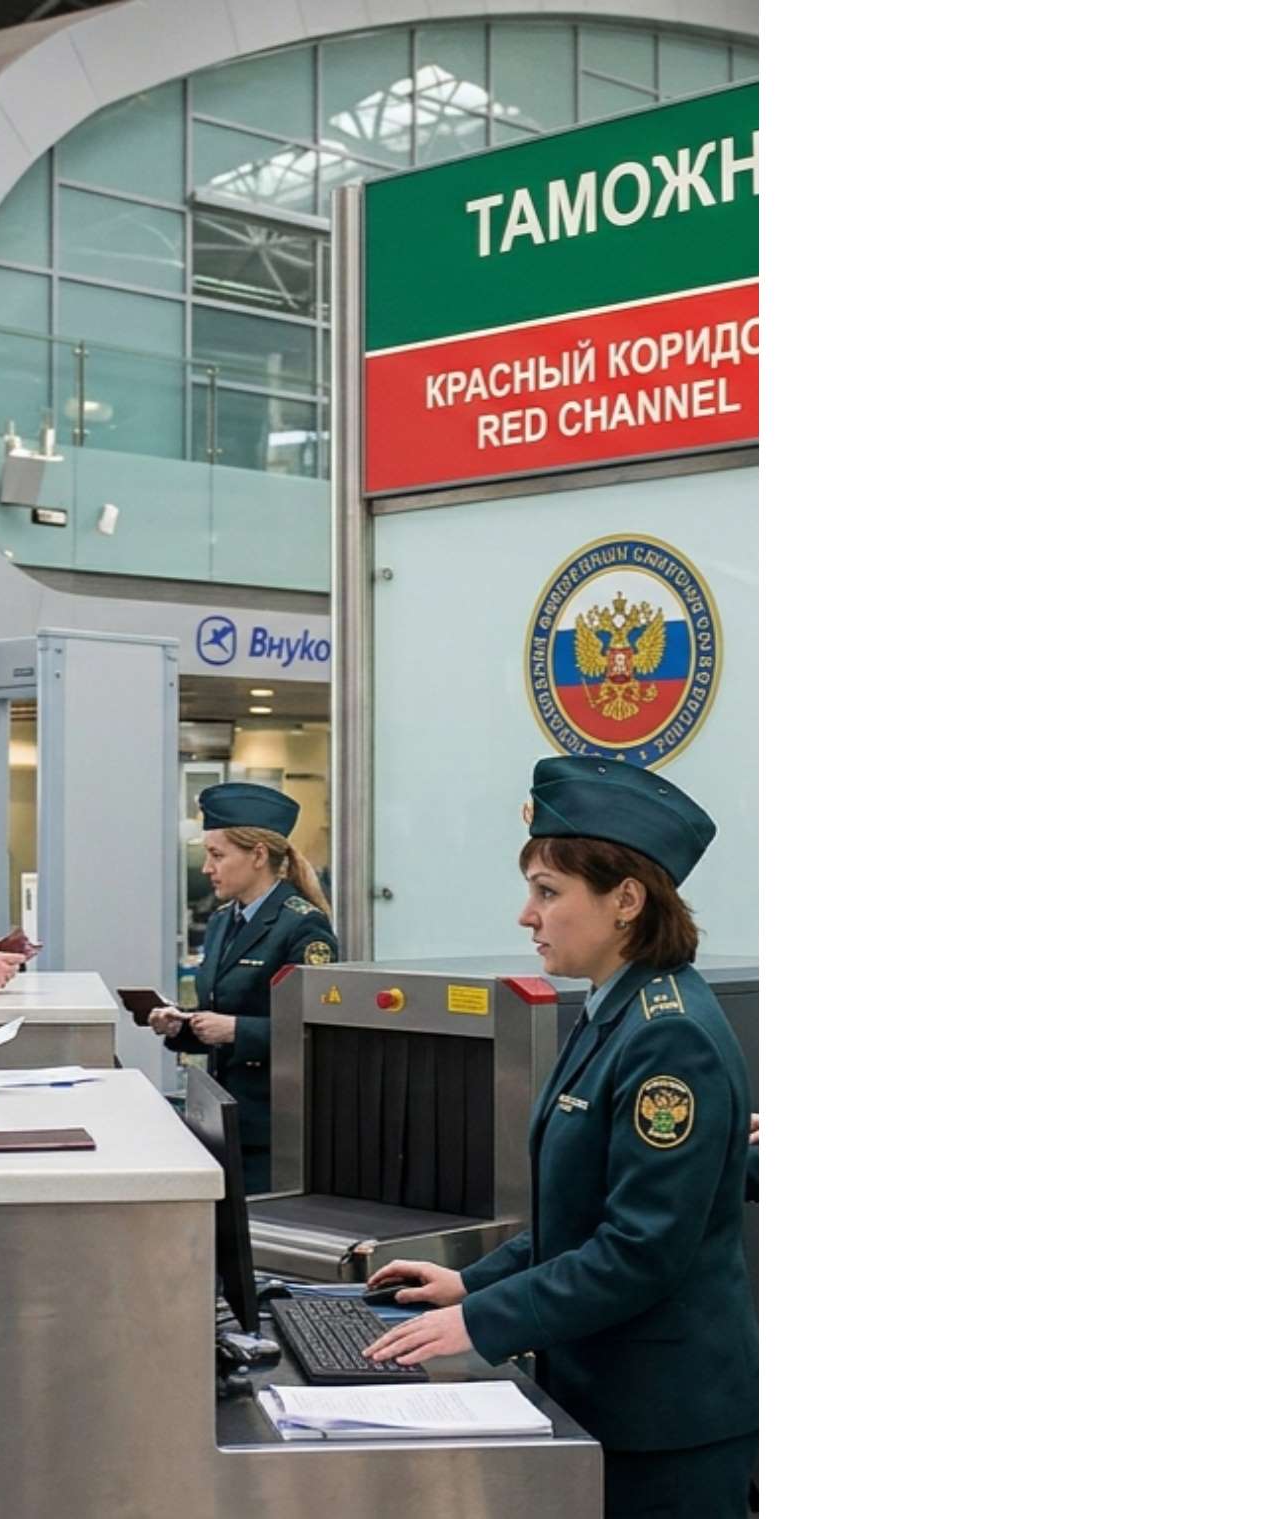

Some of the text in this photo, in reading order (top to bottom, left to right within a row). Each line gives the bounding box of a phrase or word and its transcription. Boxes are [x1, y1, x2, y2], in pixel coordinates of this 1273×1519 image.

[466, 130, 760, 258] ТАМОЖН
[426, 316, 760, 409] КРАСНЫЙ КОРИДО
[477, 377, 741, 450] RED CHANNEL
[249, 627, 332, 668] Внуко
